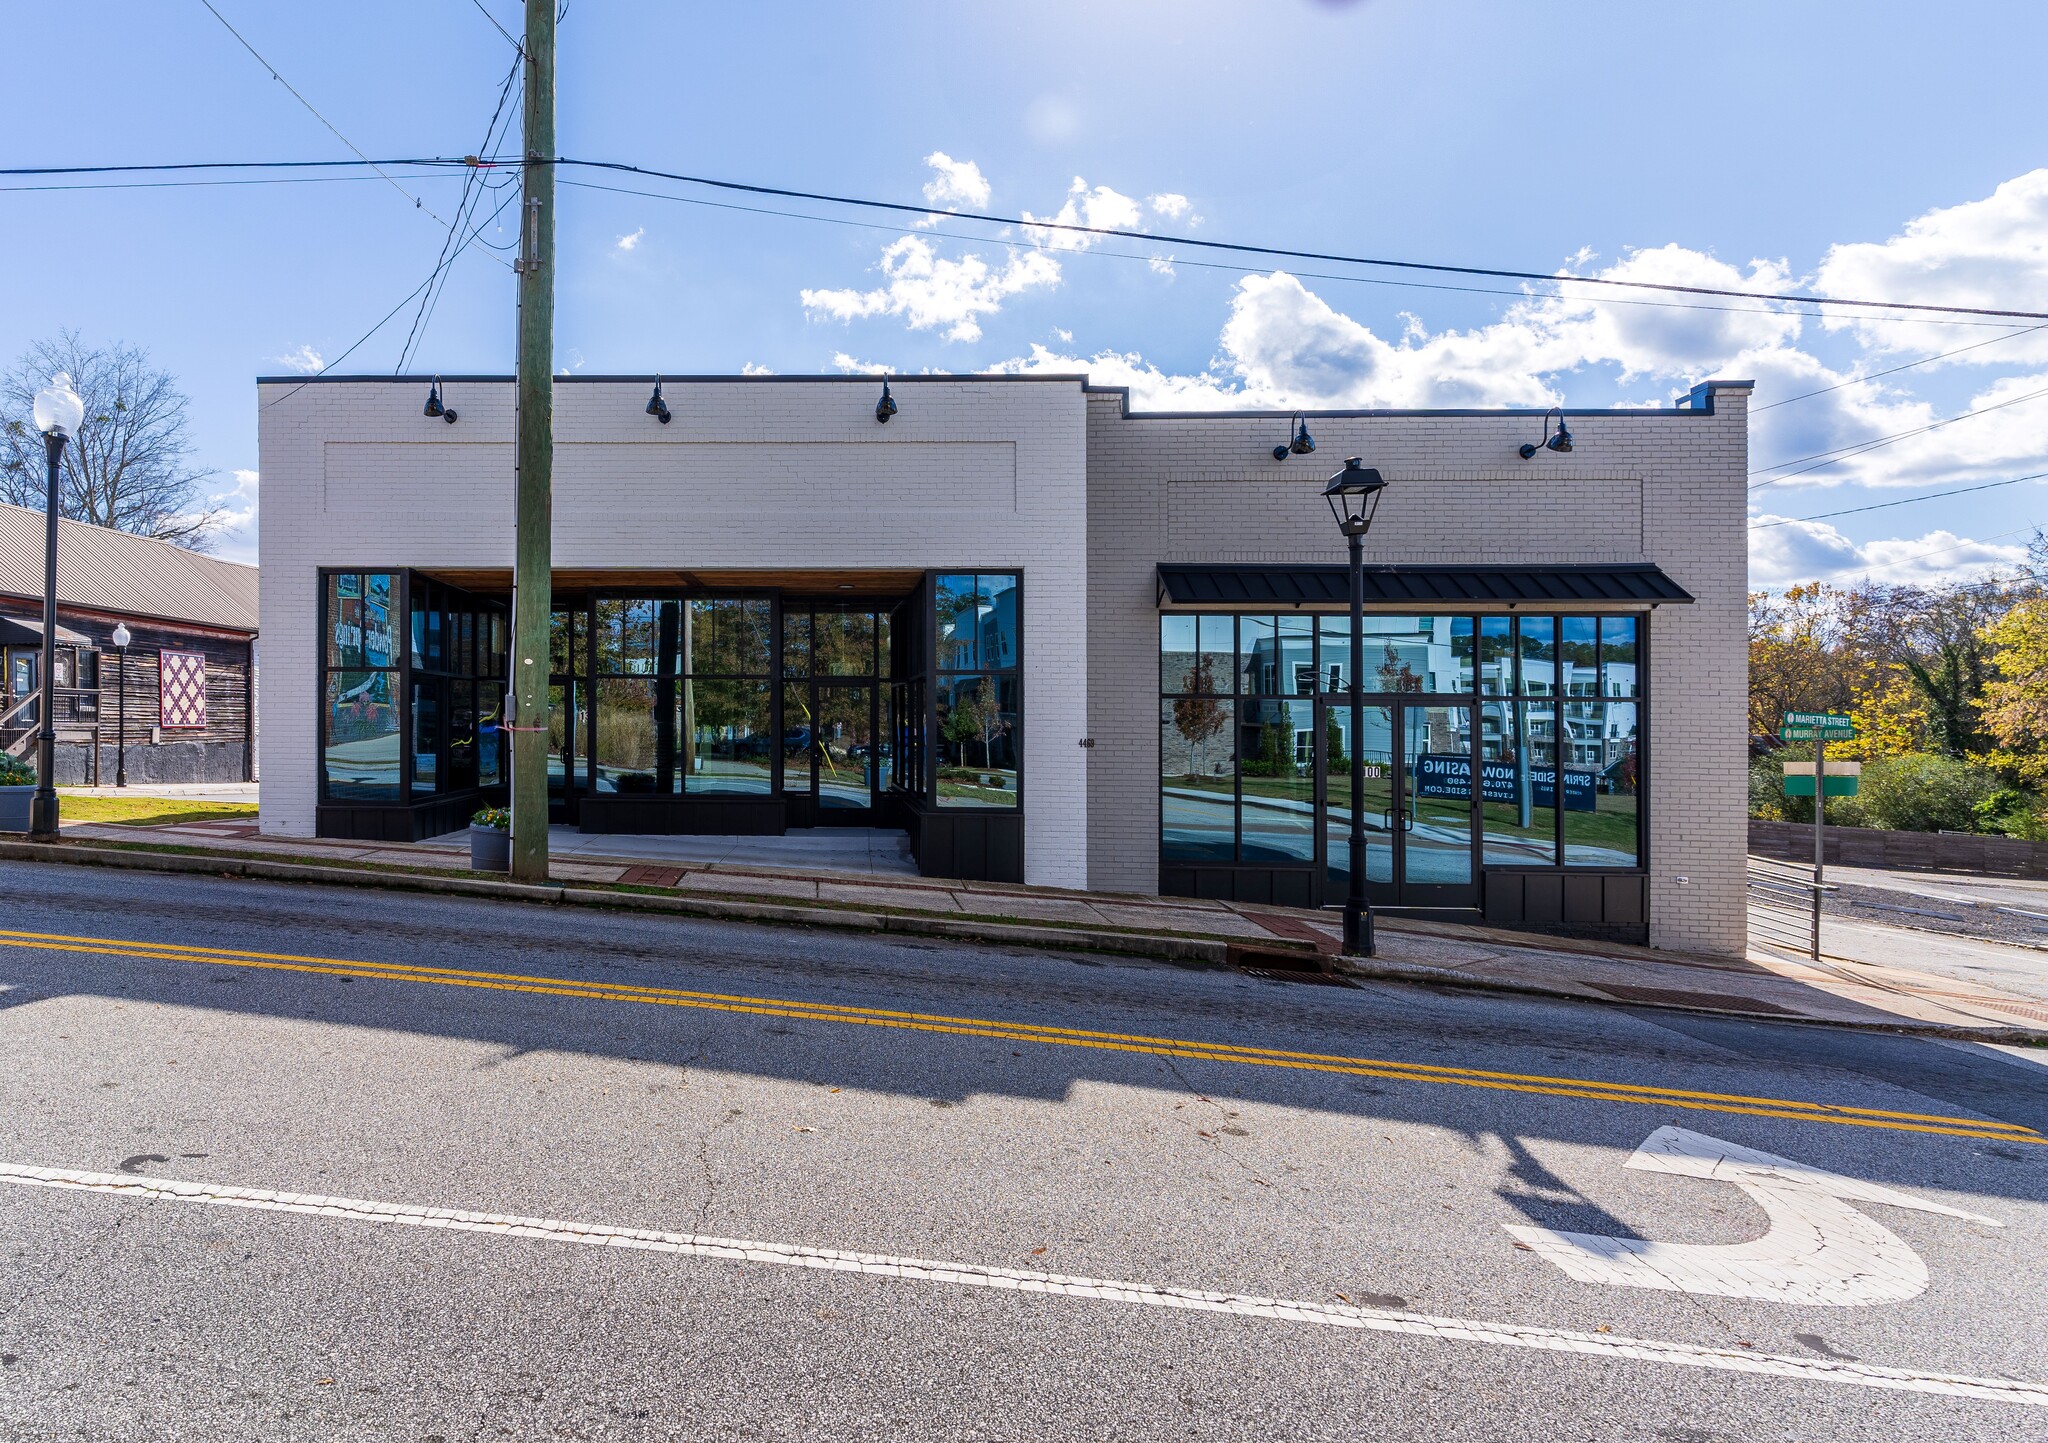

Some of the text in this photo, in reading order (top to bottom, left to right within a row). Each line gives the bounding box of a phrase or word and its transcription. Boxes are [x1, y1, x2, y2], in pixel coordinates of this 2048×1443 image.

[1795, 714, 1850, 727] MARIETTA STREET
[1793, 729, 1853, 738] MURRAY AVENUE
